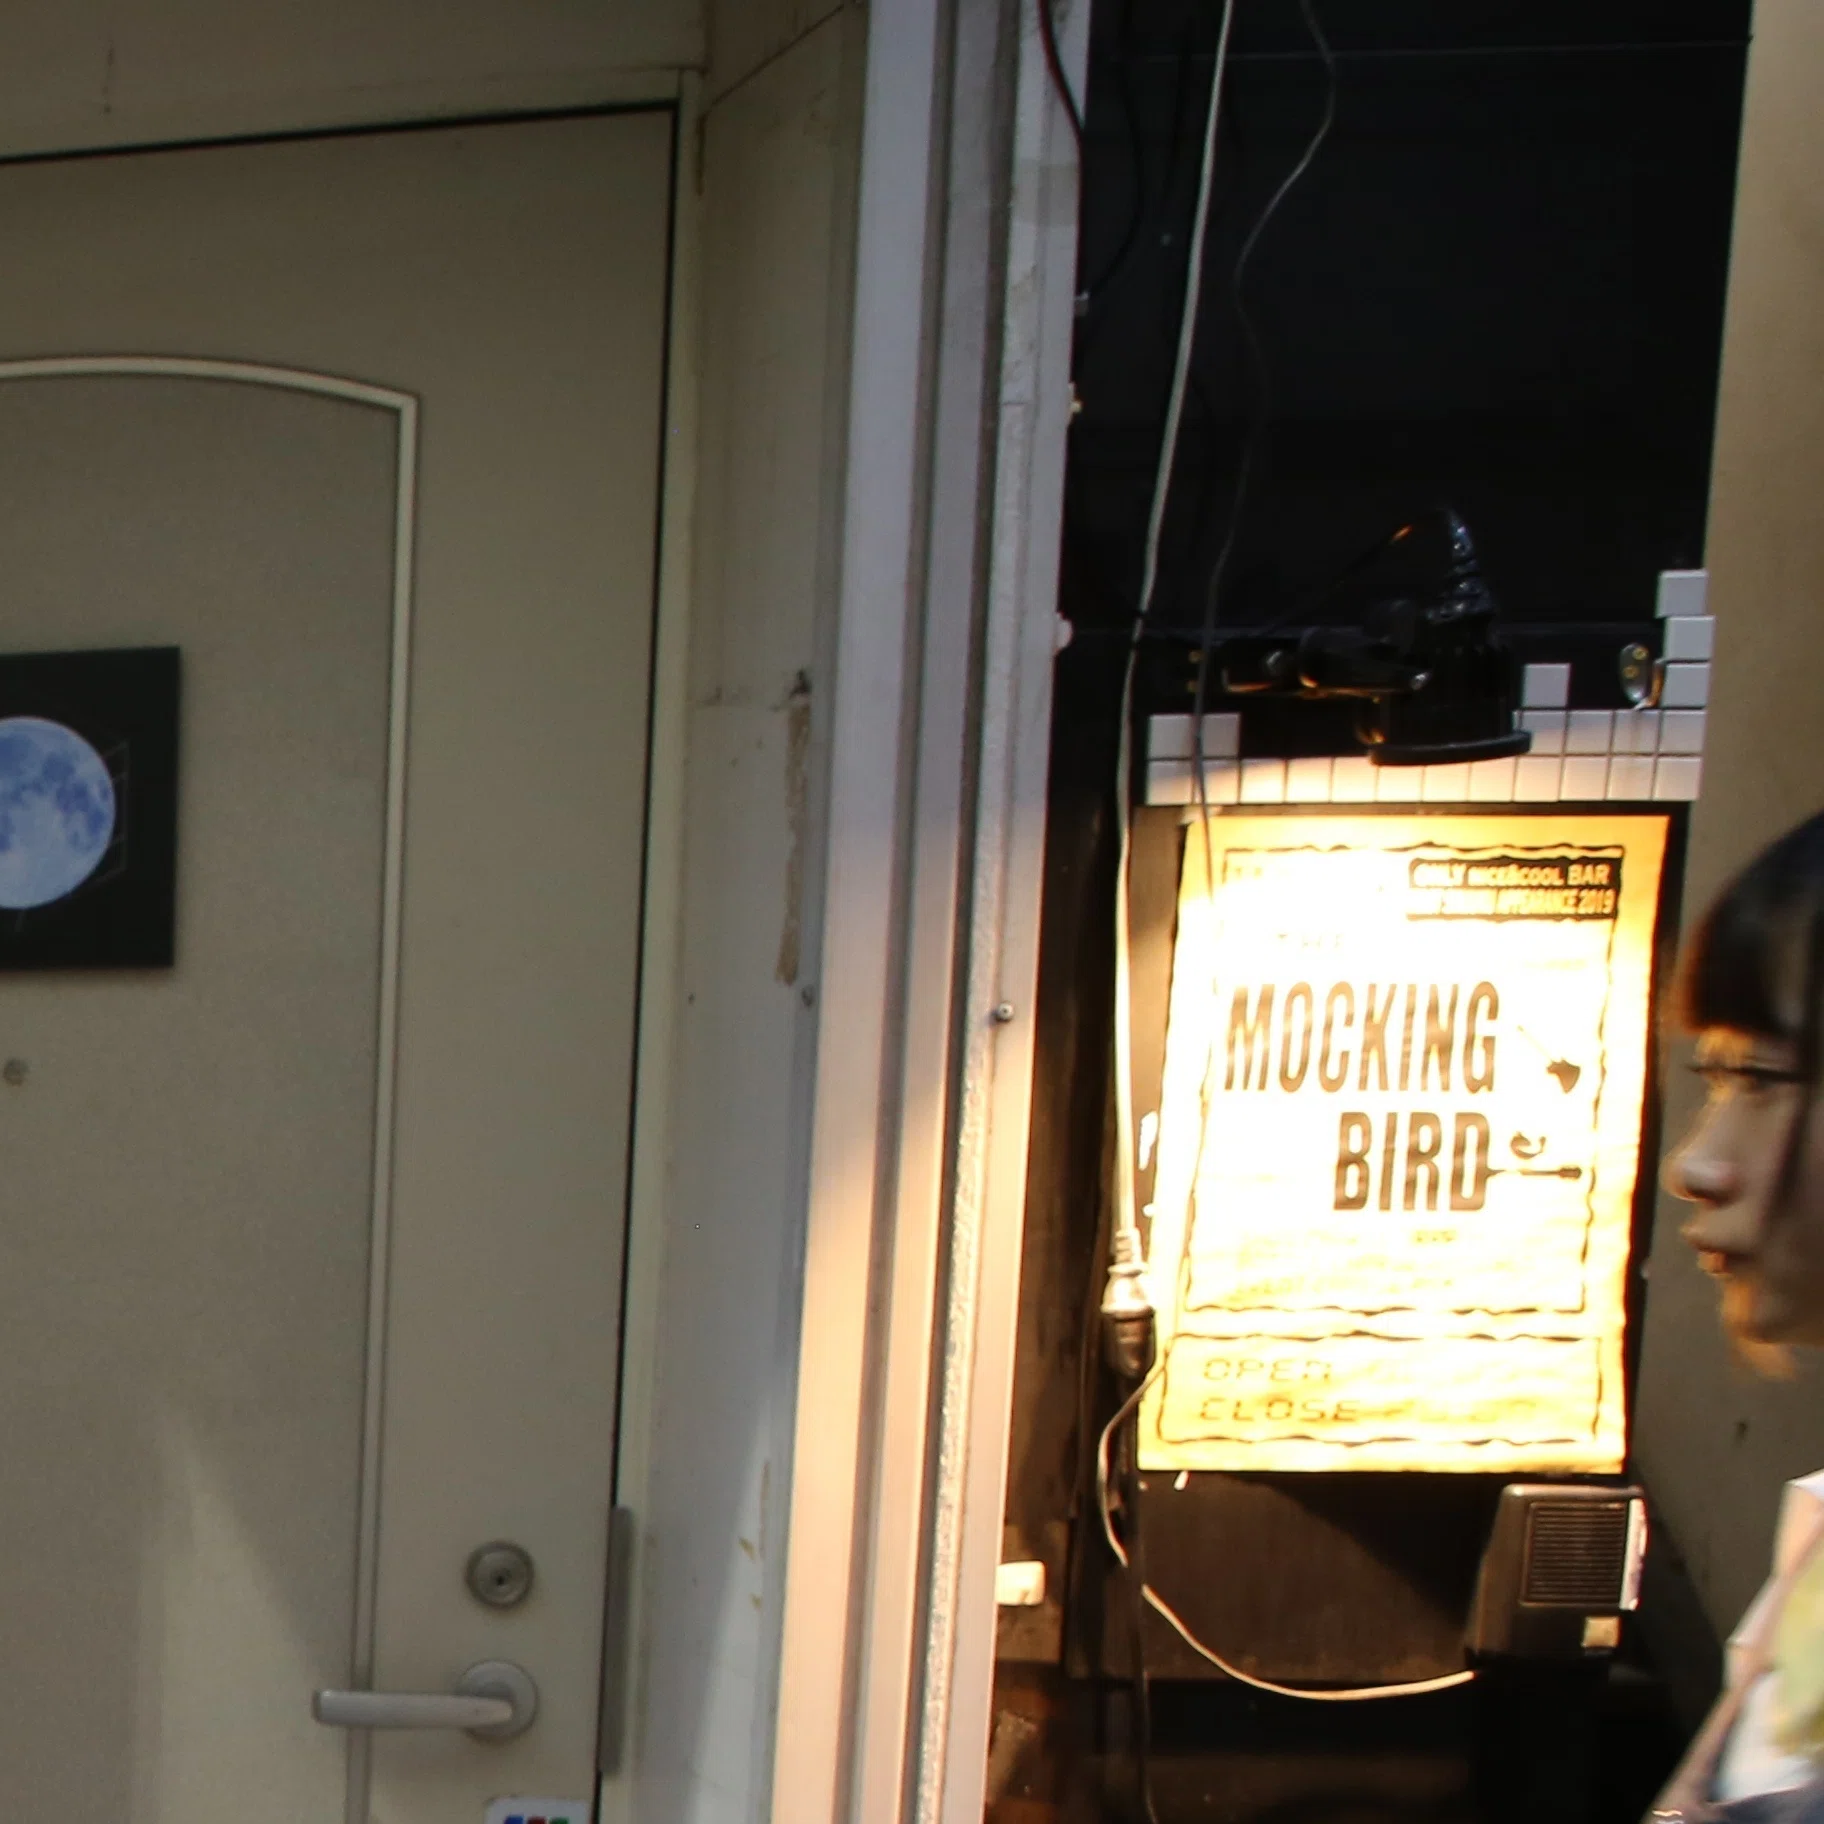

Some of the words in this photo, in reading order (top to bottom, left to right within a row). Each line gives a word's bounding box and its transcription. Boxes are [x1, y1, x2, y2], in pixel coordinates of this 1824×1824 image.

[1568, 863, 1609, 886] BAR
[1223, 980, 1500, 1094] MOCKING
[1332, 1110, 1492, 1212] BIRD
[1201, 1356, 1333, 1385] OPEN
[1198, 1397, 1359, 1425] CLOSE
